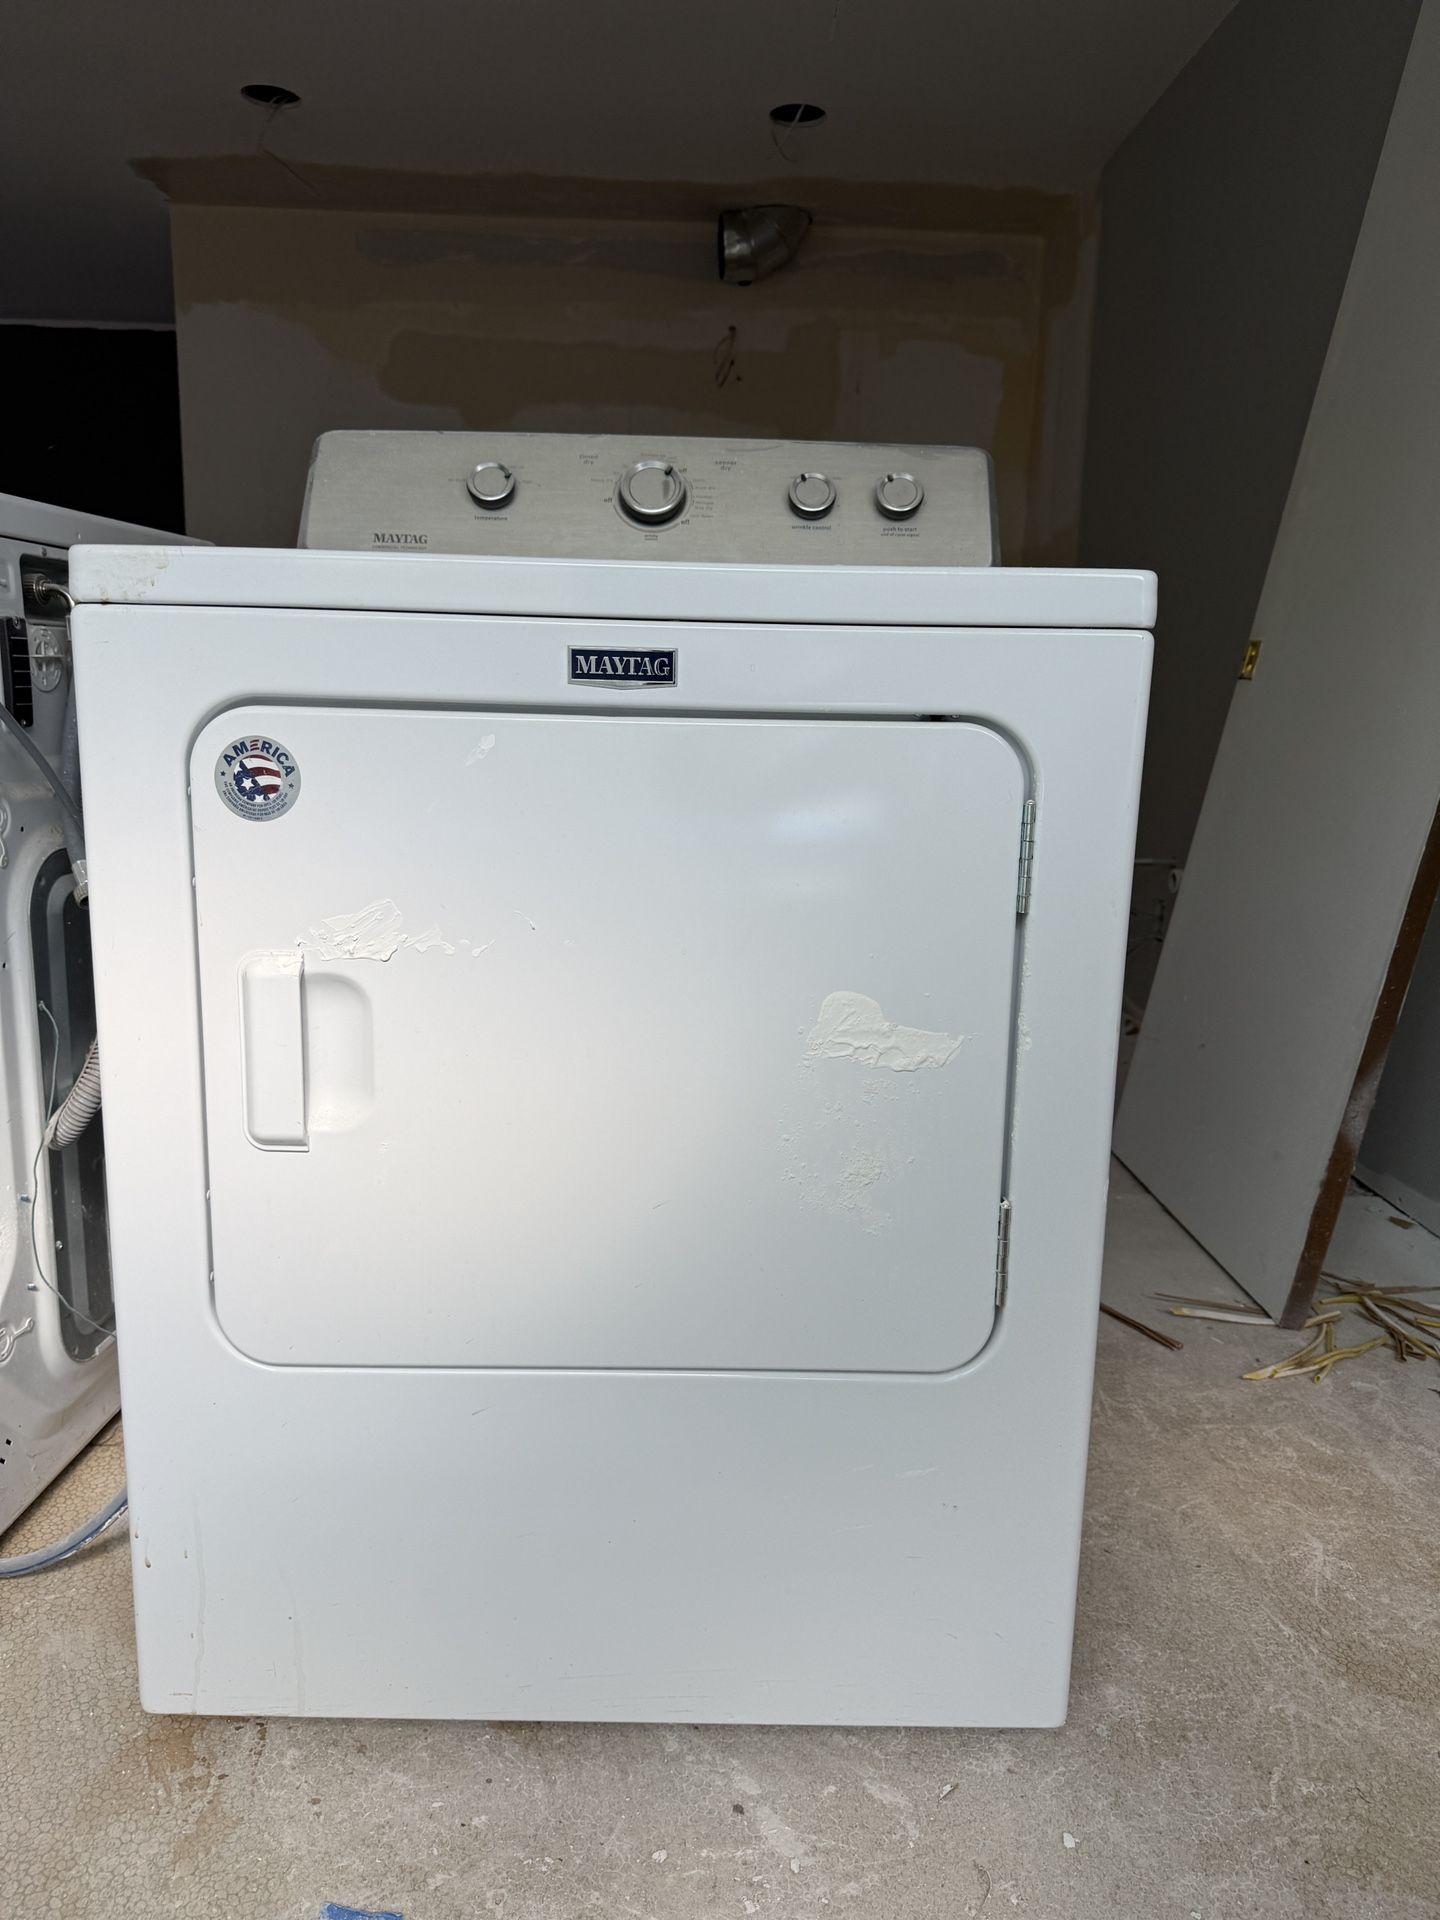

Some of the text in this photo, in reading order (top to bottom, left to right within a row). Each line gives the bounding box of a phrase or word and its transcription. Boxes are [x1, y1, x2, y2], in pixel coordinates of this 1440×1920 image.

[373, 532, 429, 545] MAYTAG
[575, 655, 670, 676] MAYTAG
[222, 739, 296, 777] AMERICA
